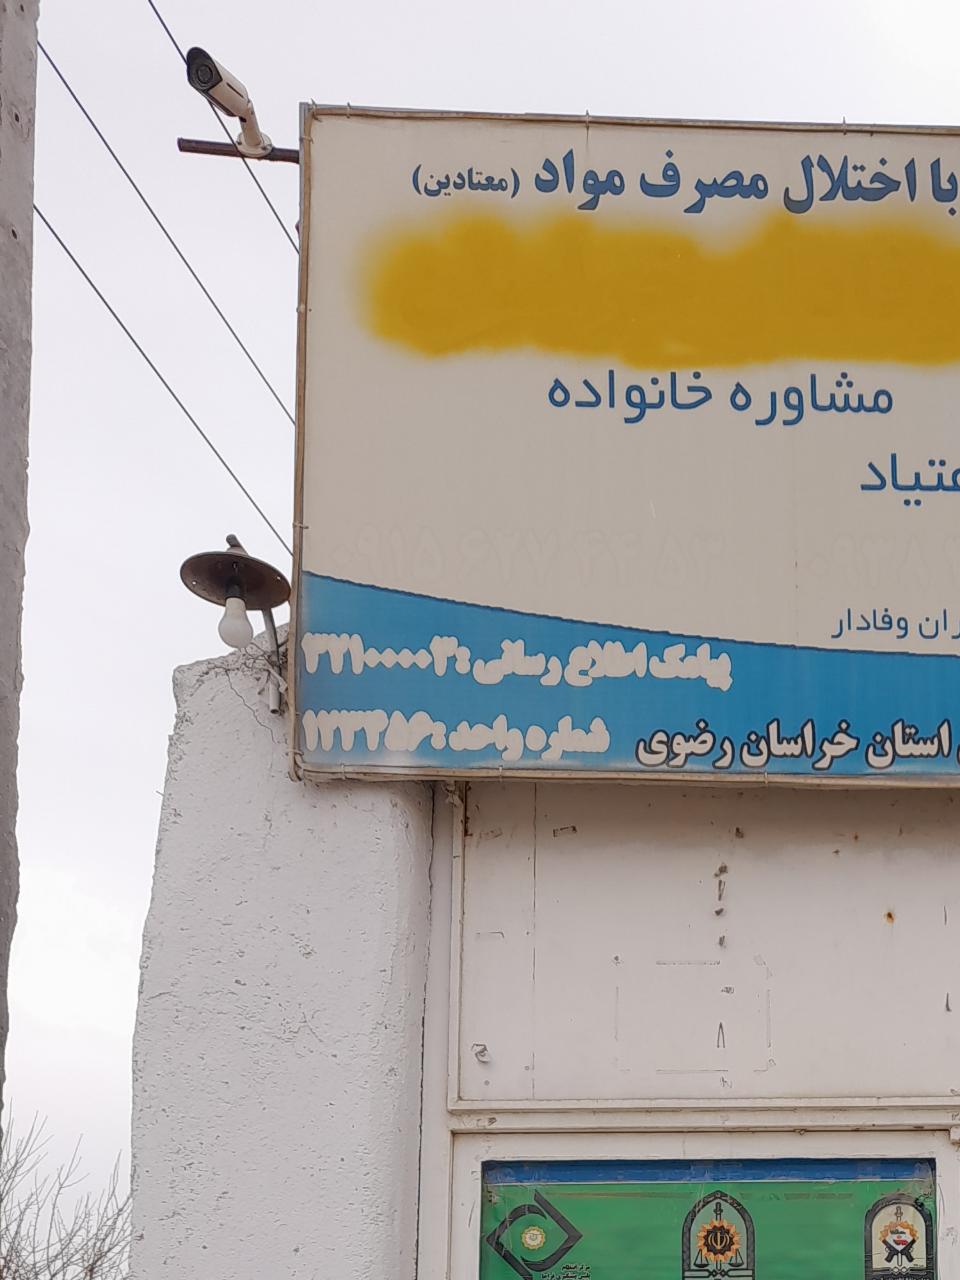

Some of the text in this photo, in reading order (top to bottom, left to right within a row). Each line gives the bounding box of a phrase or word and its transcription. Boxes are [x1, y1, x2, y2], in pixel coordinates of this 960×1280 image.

[535, 149, 624, 210] مواد
[640, 149, 768, 212] مصرف
[783, 154, 916, 214] اختلال
[930, 158, 958, 216] با
[547, 369, 893, 425] مشاوره خانواده
[831, 608, 908, 638] وفادار
[635, 718, 735, 769] رضوی
[740, 719, 859, 770] خراسان
[865, 720, 952, 768] استان
